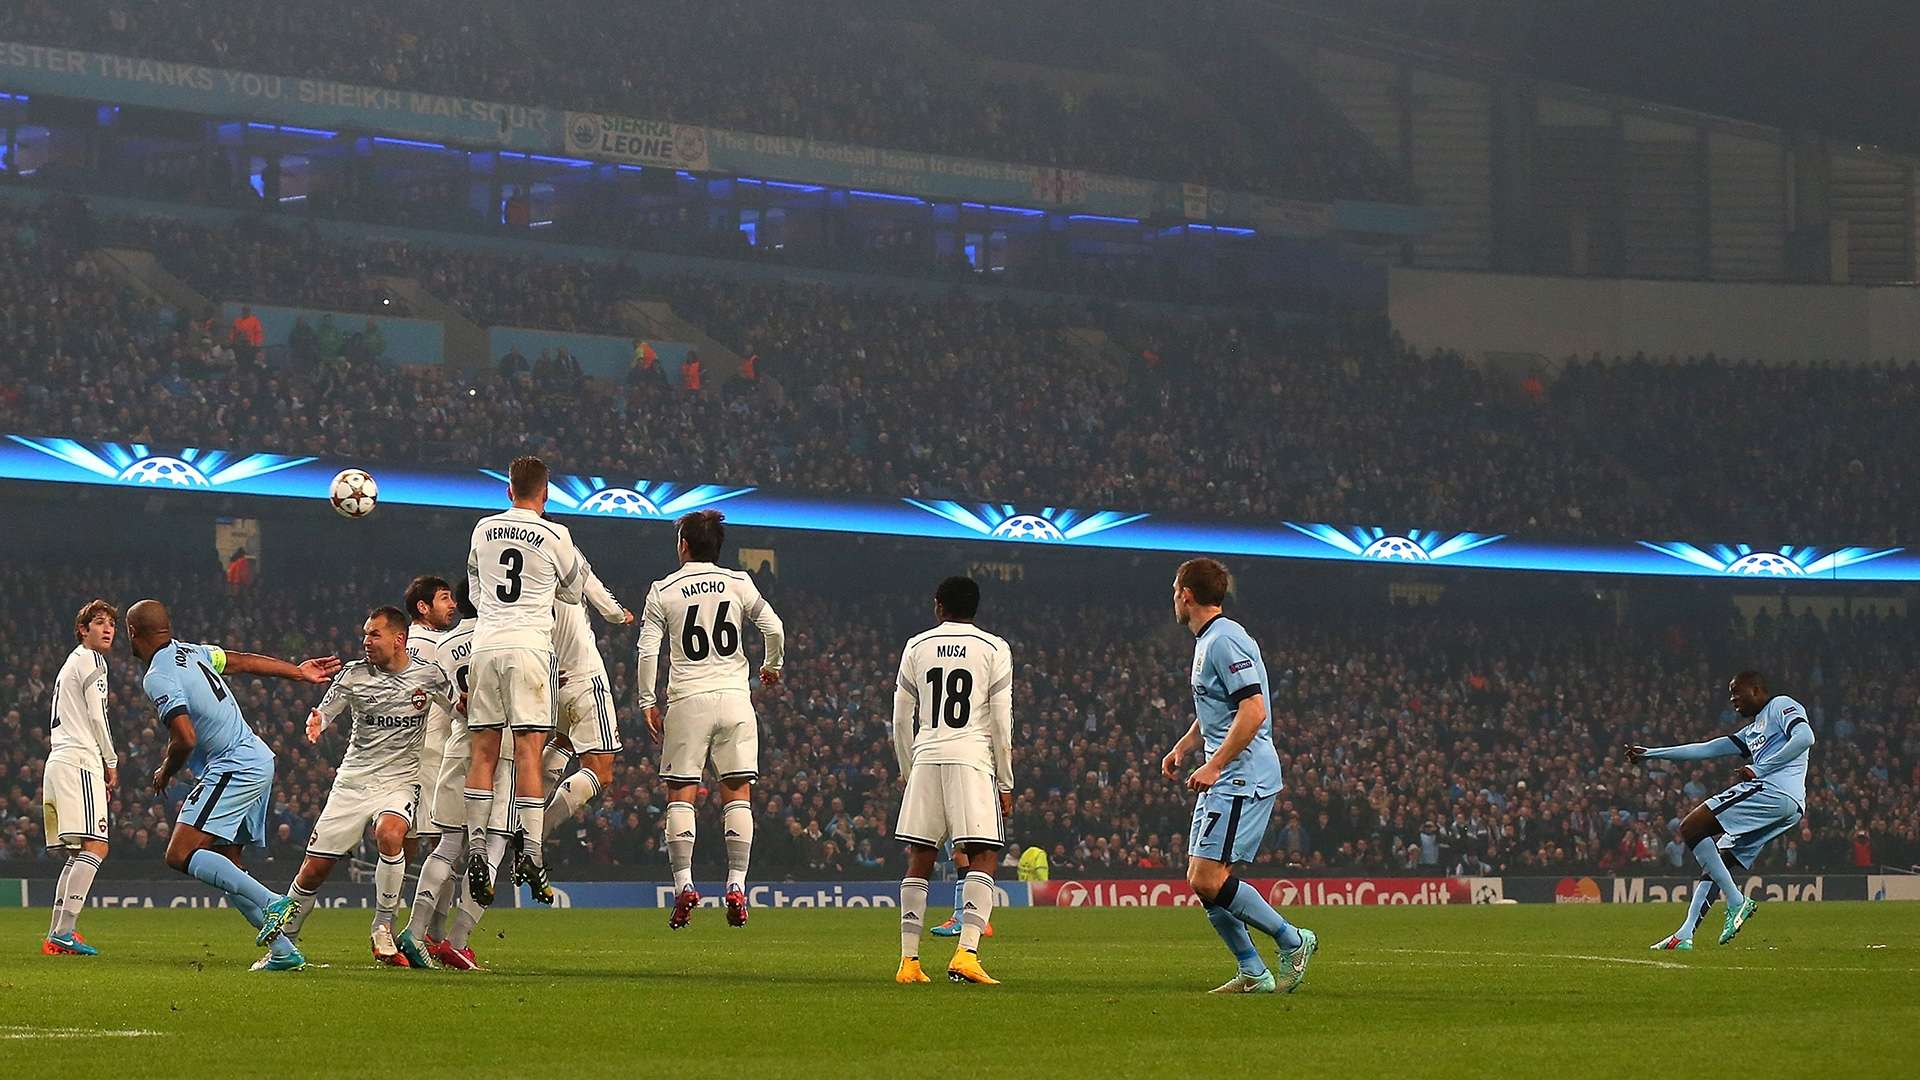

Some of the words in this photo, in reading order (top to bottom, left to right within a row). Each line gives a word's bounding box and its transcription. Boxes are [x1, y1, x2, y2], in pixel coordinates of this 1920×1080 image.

[93, 53, 213, 91] THANKS
[298, 79, 400, 110] SHEIKH
[601, 115, 672, 138] SIERRA
[601, 133, 673, 158] LEONE
[711, 130, 746, 151] The
[753, 135, 804, 158] ONLY
[808, 142, 876, 166] football
[882, 152, 925, 169] team
[931, 154, 947, 173] to
[953, 161, 1001, 180] come
[485, 527, 544, 548] WERNBLOOM
[496, 548, 523, 603] 3
[681, 581, 725, 598] NATCHO
[682, 601, 739, 661] 66
[937, 645, 966, 658] MUSA
[197, 661, 227, 702] 4
[926, 667, 973, 728] 18
[188, 785, 205, 805] 4
[1203, 812, 1222, 837] 7
